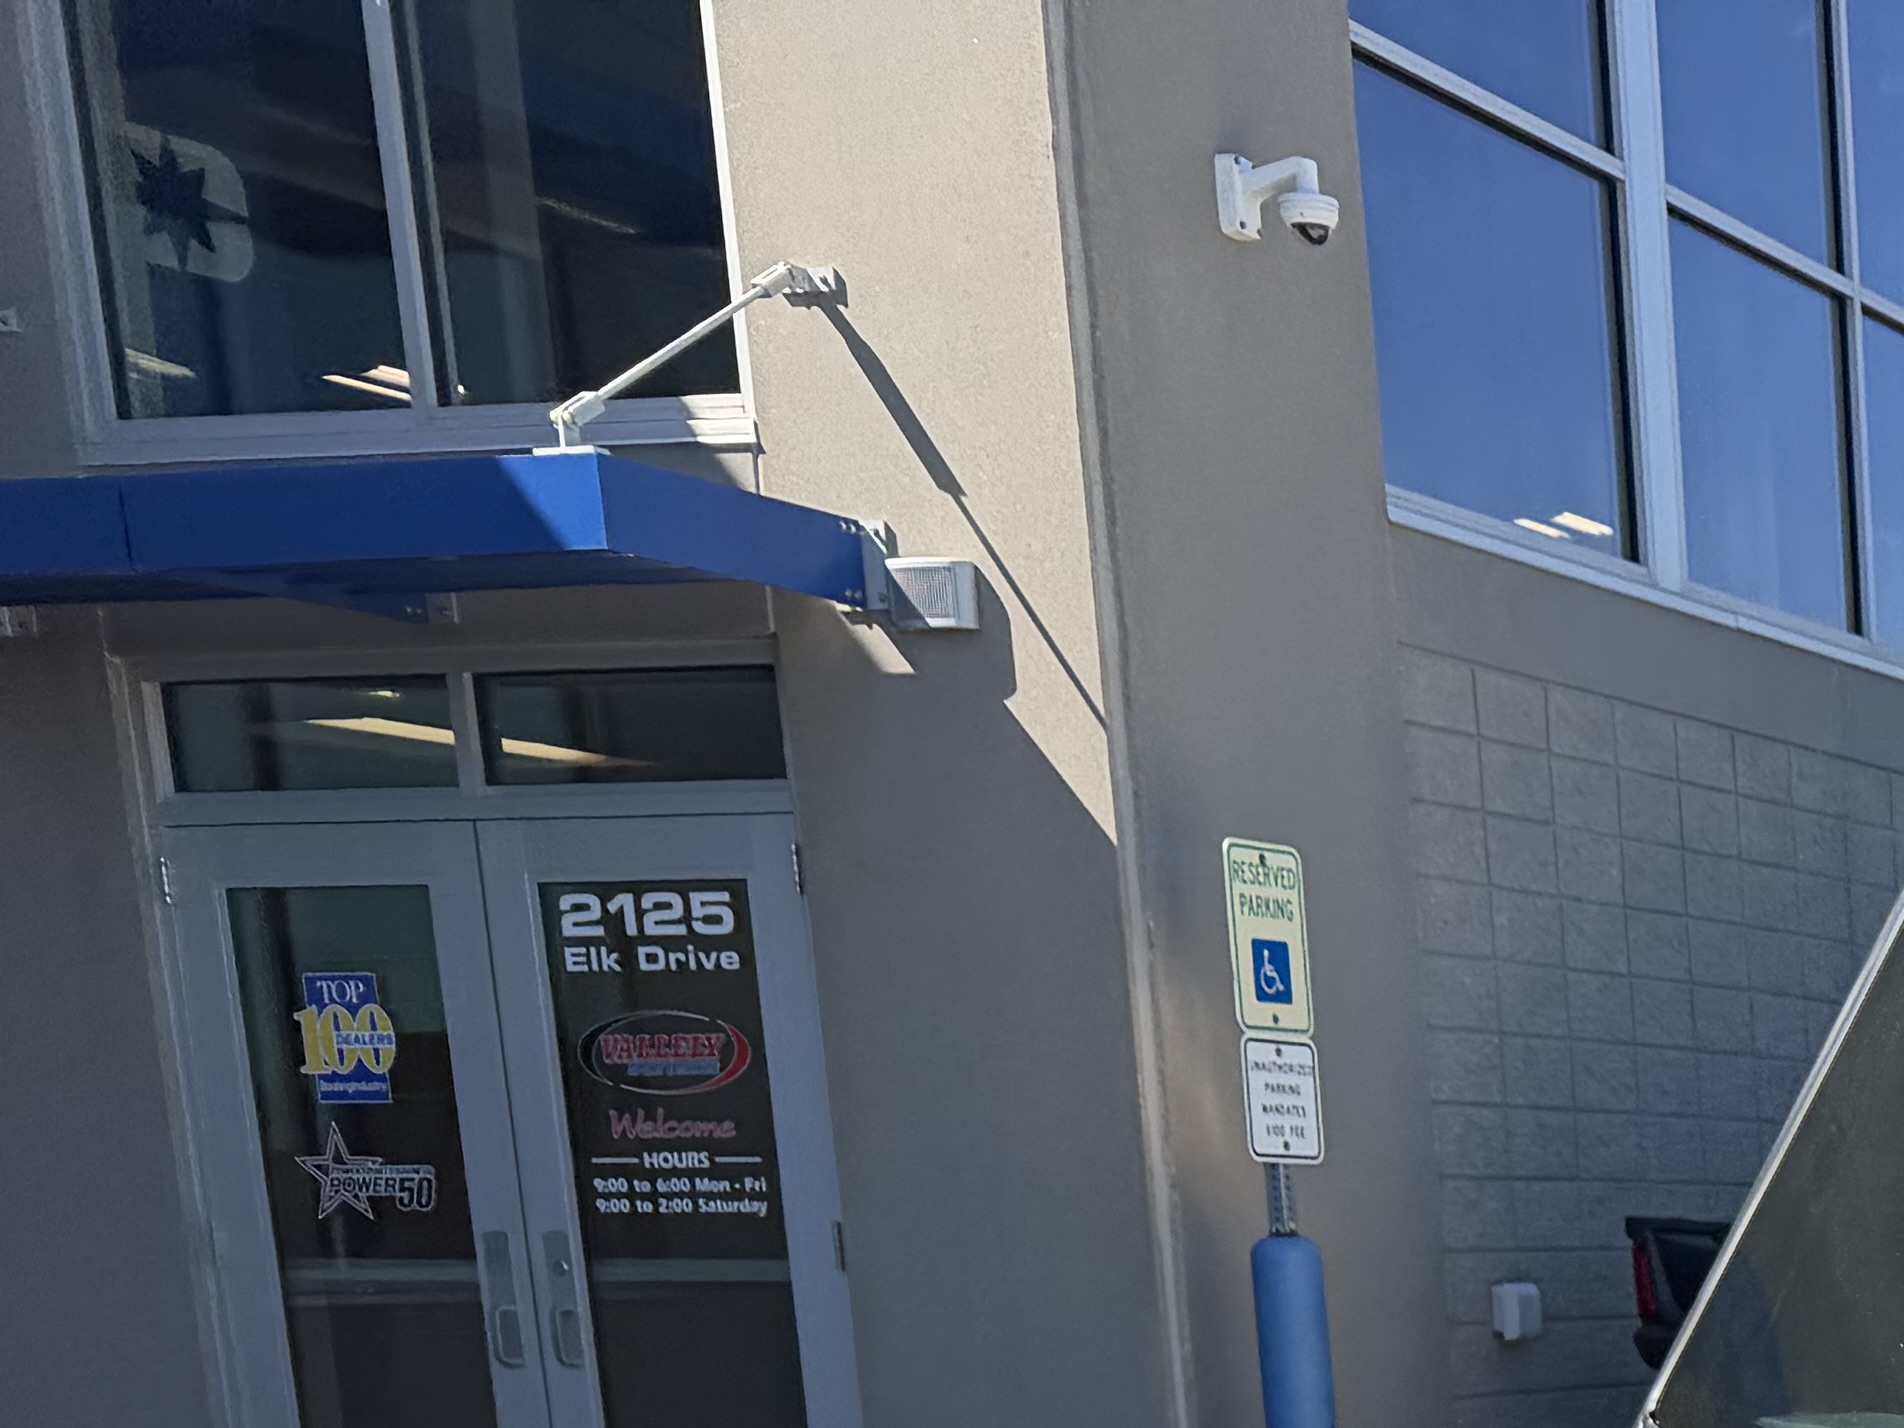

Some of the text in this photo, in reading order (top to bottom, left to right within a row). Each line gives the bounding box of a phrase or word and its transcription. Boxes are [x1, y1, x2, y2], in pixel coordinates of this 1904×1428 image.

[1232, 859, 1296, 890] RESERVED
[559, 891, 735, 937] 2125
[1239, 892, 1294, 922] PARKING
[564, 945, 740, 972] Elk Drive
[316, 980, 364, 1003] TOP
[293, 1003, 396, 1074] 100
[608, 1107, 736, 1139] Welcome
[643, 1151, 711, 1169] HOURS
[330, 1177, 433, 1210] POWER 50
[593, 1178, 628, 1193] 9:00
[633, 1179, 651, 1193] to
[695, 1178, 731, 1192] Mon
[744, 1176, 767, 1192] Fri
[596, 1197, 768, 1217] 9:00 to 2:00 Saturday
